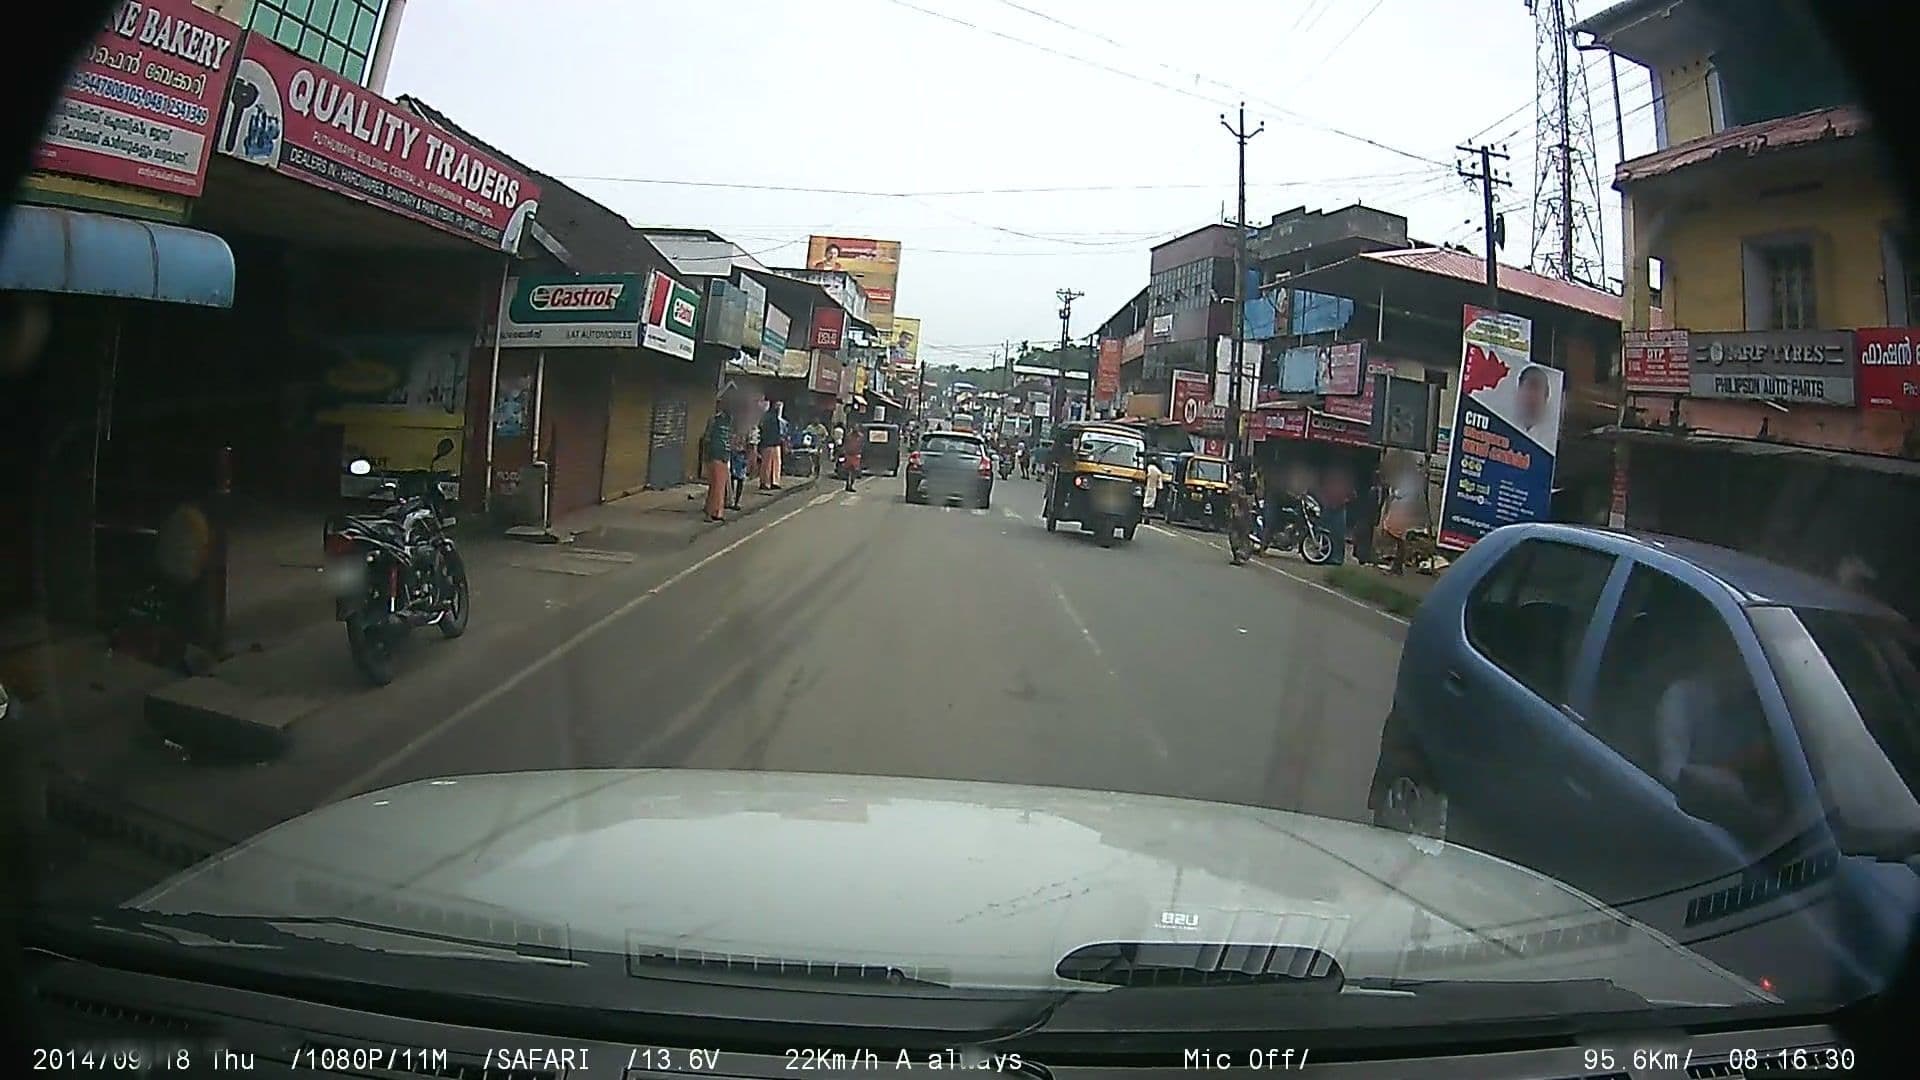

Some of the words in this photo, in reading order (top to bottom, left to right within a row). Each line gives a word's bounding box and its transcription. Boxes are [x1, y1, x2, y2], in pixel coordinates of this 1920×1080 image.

[139, 9, 231, 70] BAKERY
[289, 69, 420, 159] QUALITY
[425, 133, 520, 208] TRADERS
[290, 147, 328, 174] DEALERS
[550, 287, 618, 307] Castrol
[1862, 336, 1911, 365] ഫാഷൻ
[1762, 378, 1788, 395] AUTO
[1791, 379, 1824, 398] PARTS
[1465, 410, 1489, 430] CITU
